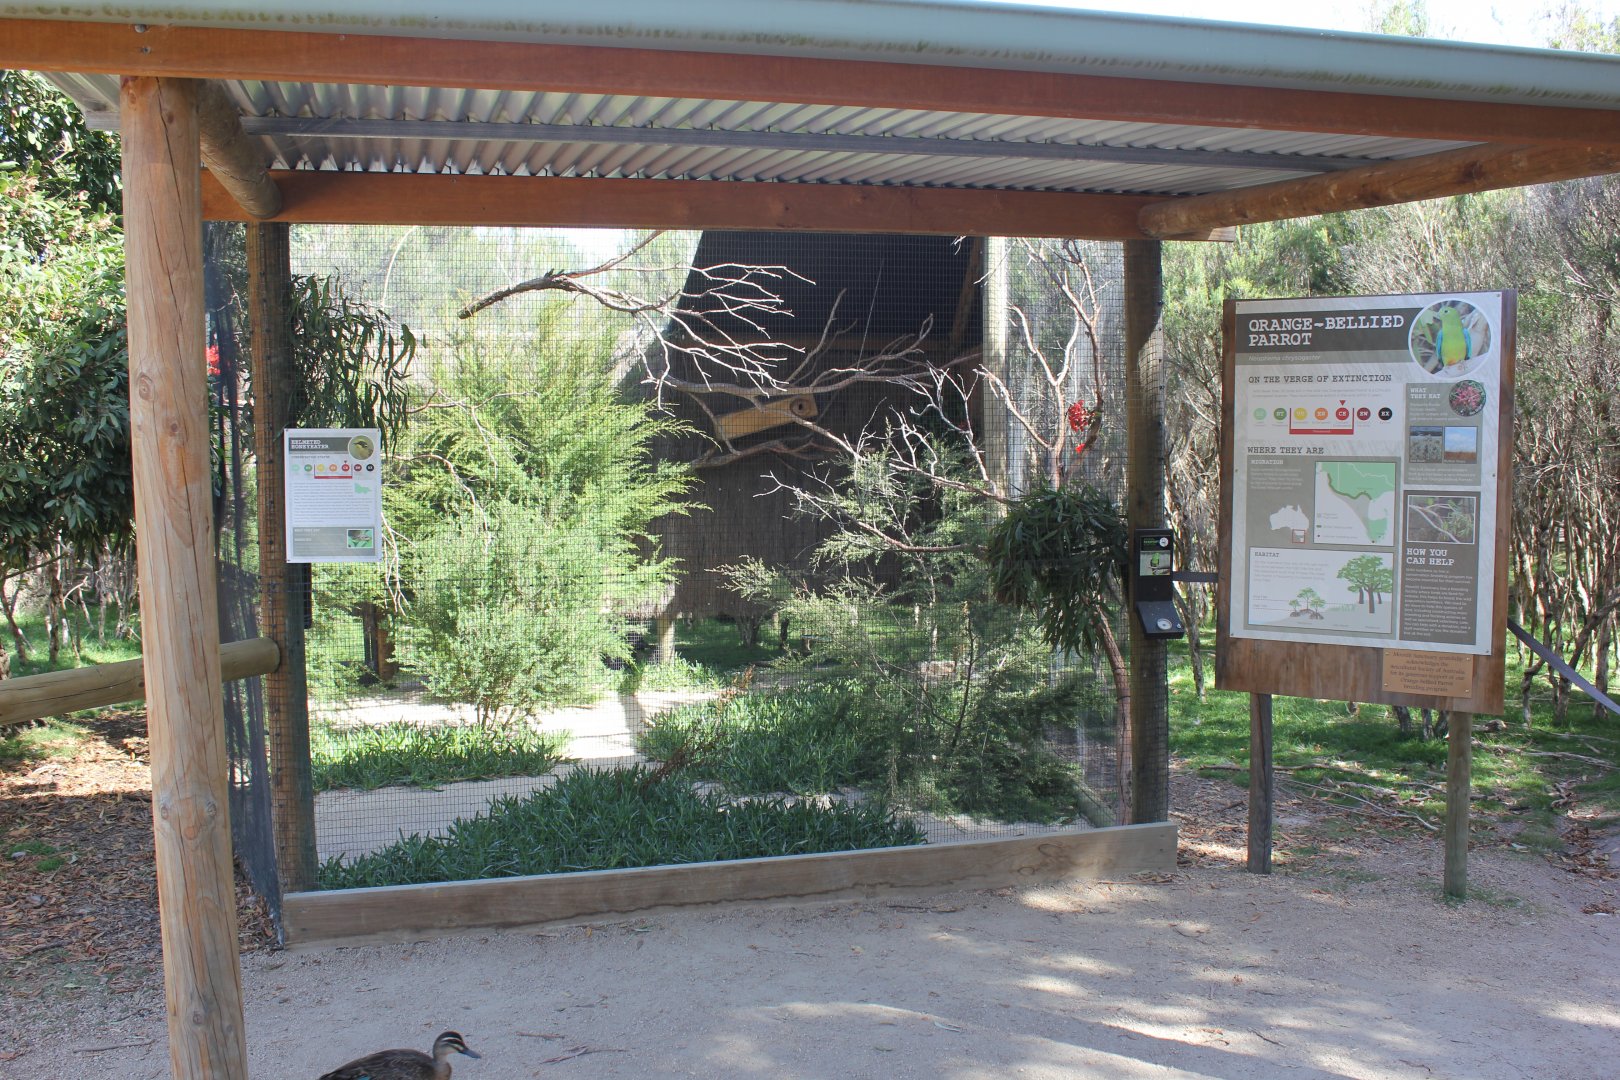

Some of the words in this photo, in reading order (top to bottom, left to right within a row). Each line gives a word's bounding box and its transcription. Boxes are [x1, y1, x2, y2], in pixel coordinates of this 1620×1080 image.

[1249, 315, 1404, 332] ORANGE-BELLIED
[1248, 332, 1312, 347] PARROT
[1248, 376, 1260, 384] ON
[1263, 375, 1280, 383] THE
[1283, 375, 1313, 383] VERGE
[1316, 375, 1329, 383] OF
[1332, 374, 1392, 383] EXTINCTION
[1247, 446, 1277, 454] WHERE
[1279, 446, 1303, 454] THEY
[1305, 447, 1325, 455] ARE
[1406, 547, 1426, 556] HOW
[1429, 549, 1448, 557] YOU
[1406, 556, 1426, 565] CAN
[1429, 557, 1455, 566] HELP
